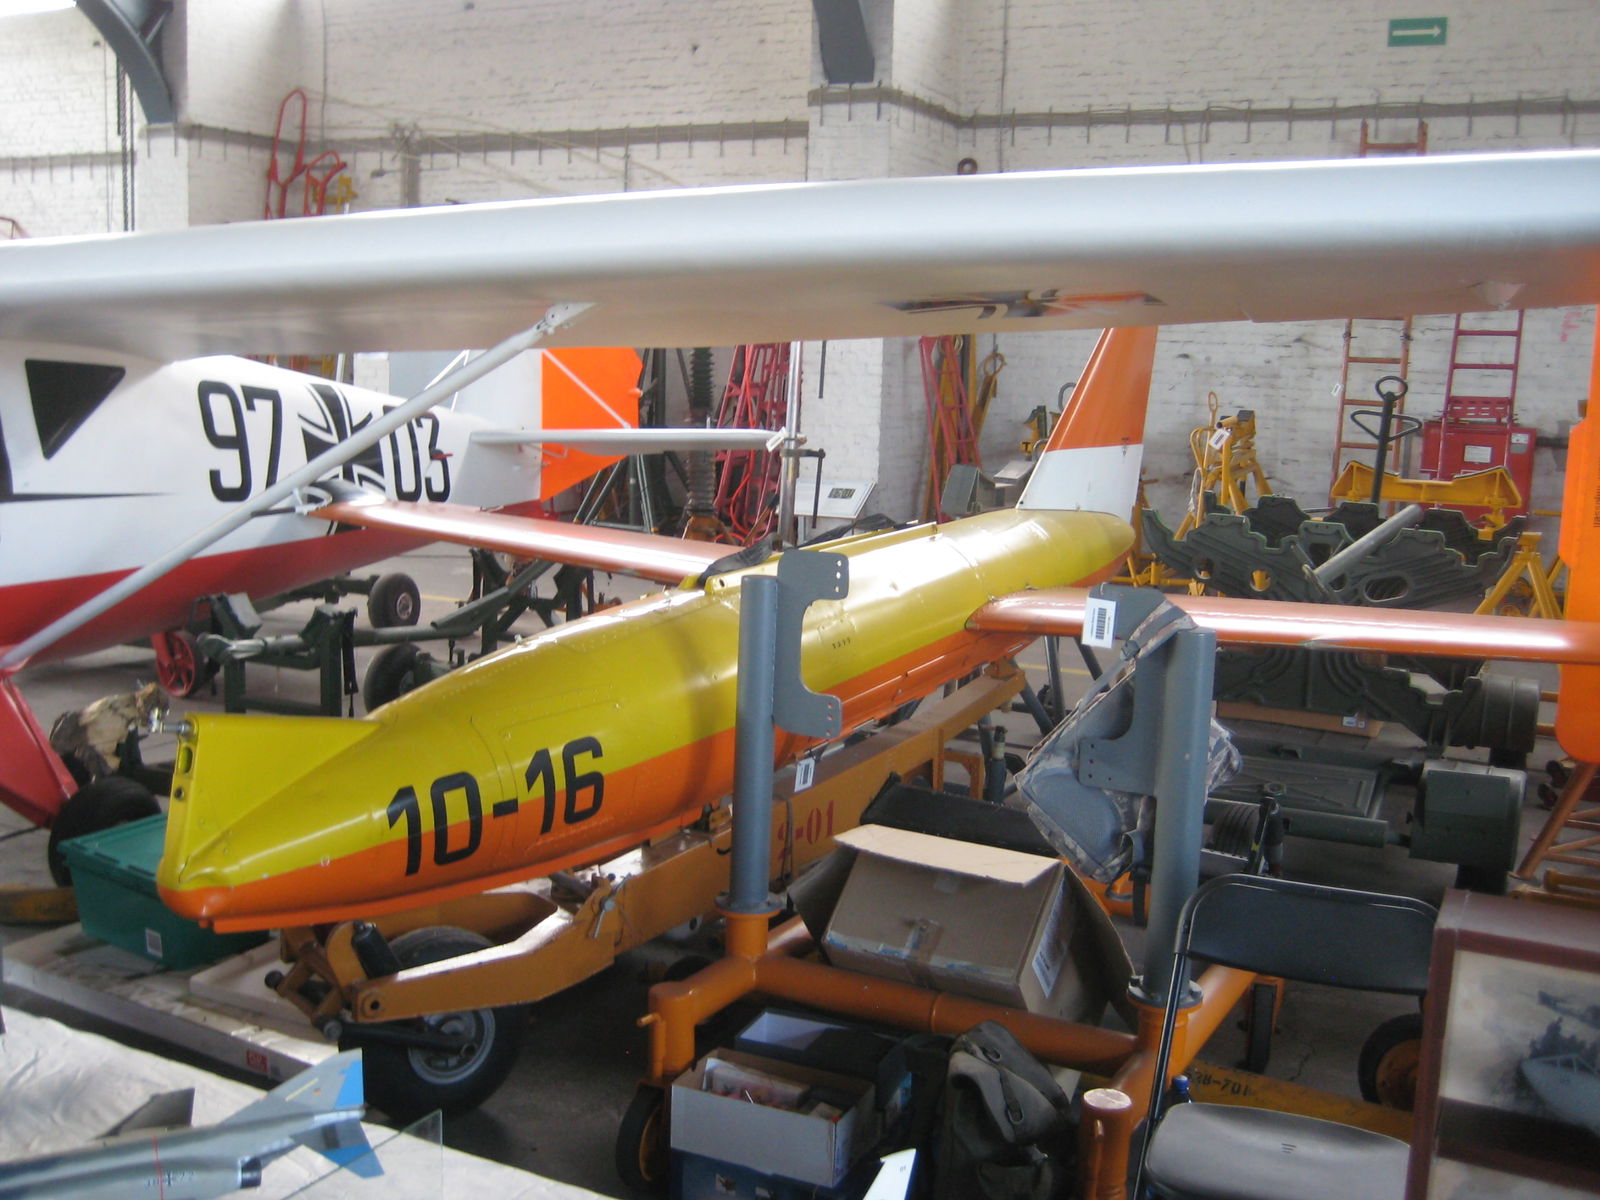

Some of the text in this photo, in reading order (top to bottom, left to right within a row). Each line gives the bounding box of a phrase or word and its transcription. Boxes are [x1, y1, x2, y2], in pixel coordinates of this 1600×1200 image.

[198, 380, 451, 502] 97 03
[386, 736, 605, 877] 10-16
